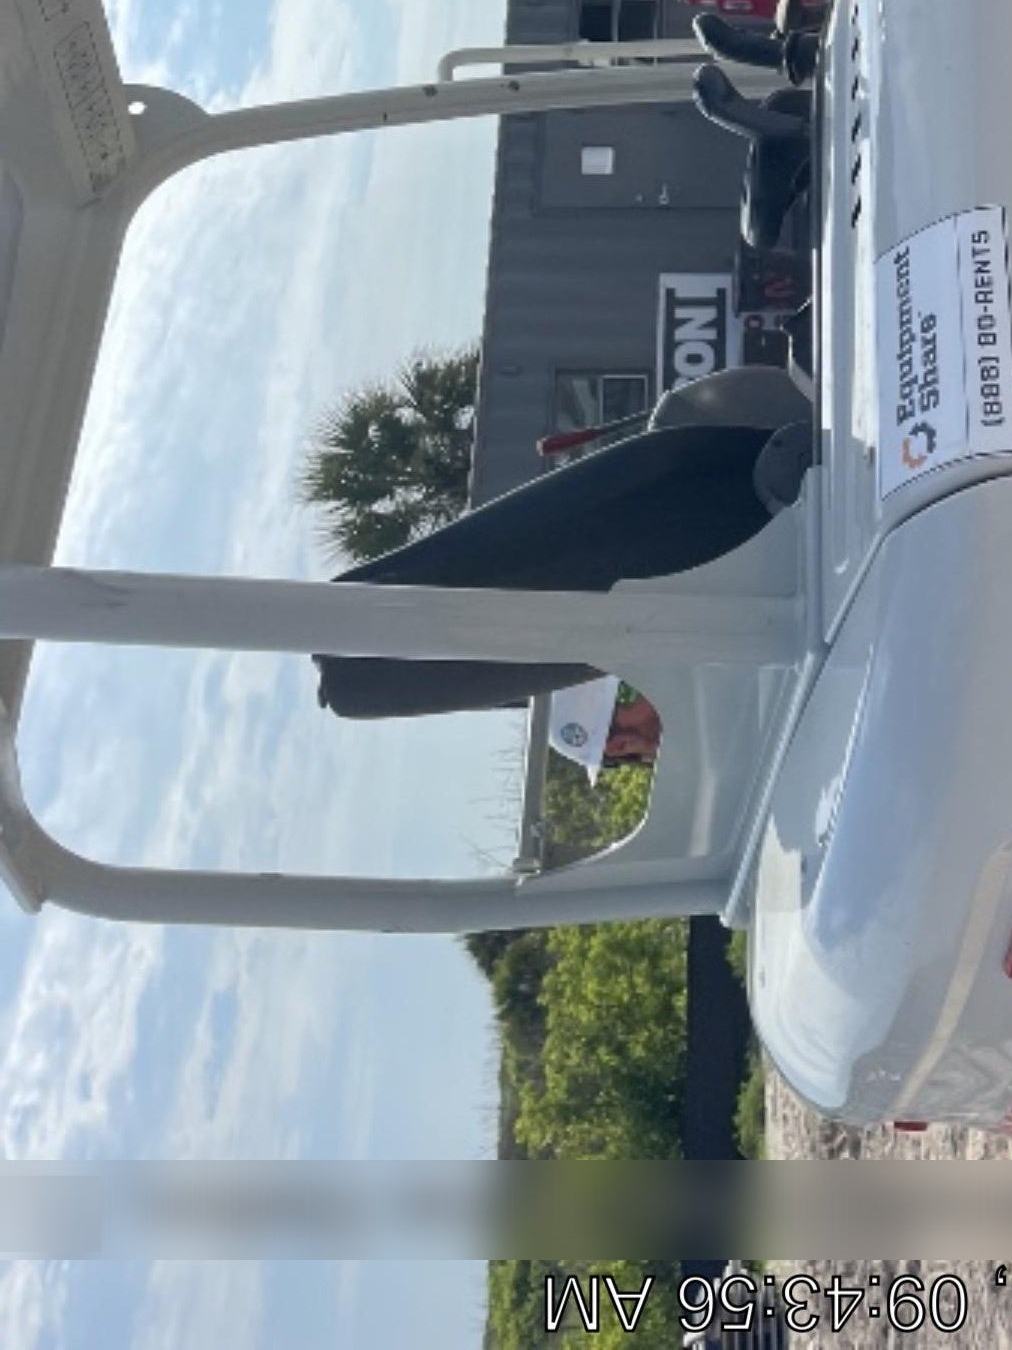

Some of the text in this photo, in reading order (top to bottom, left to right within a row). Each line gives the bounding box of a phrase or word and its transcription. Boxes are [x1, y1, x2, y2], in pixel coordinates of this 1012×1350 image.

[893, 245, 918, 427] Equipment
[918, 312, 939, 414] Share
[977, 356, 1005, 428] (888)
